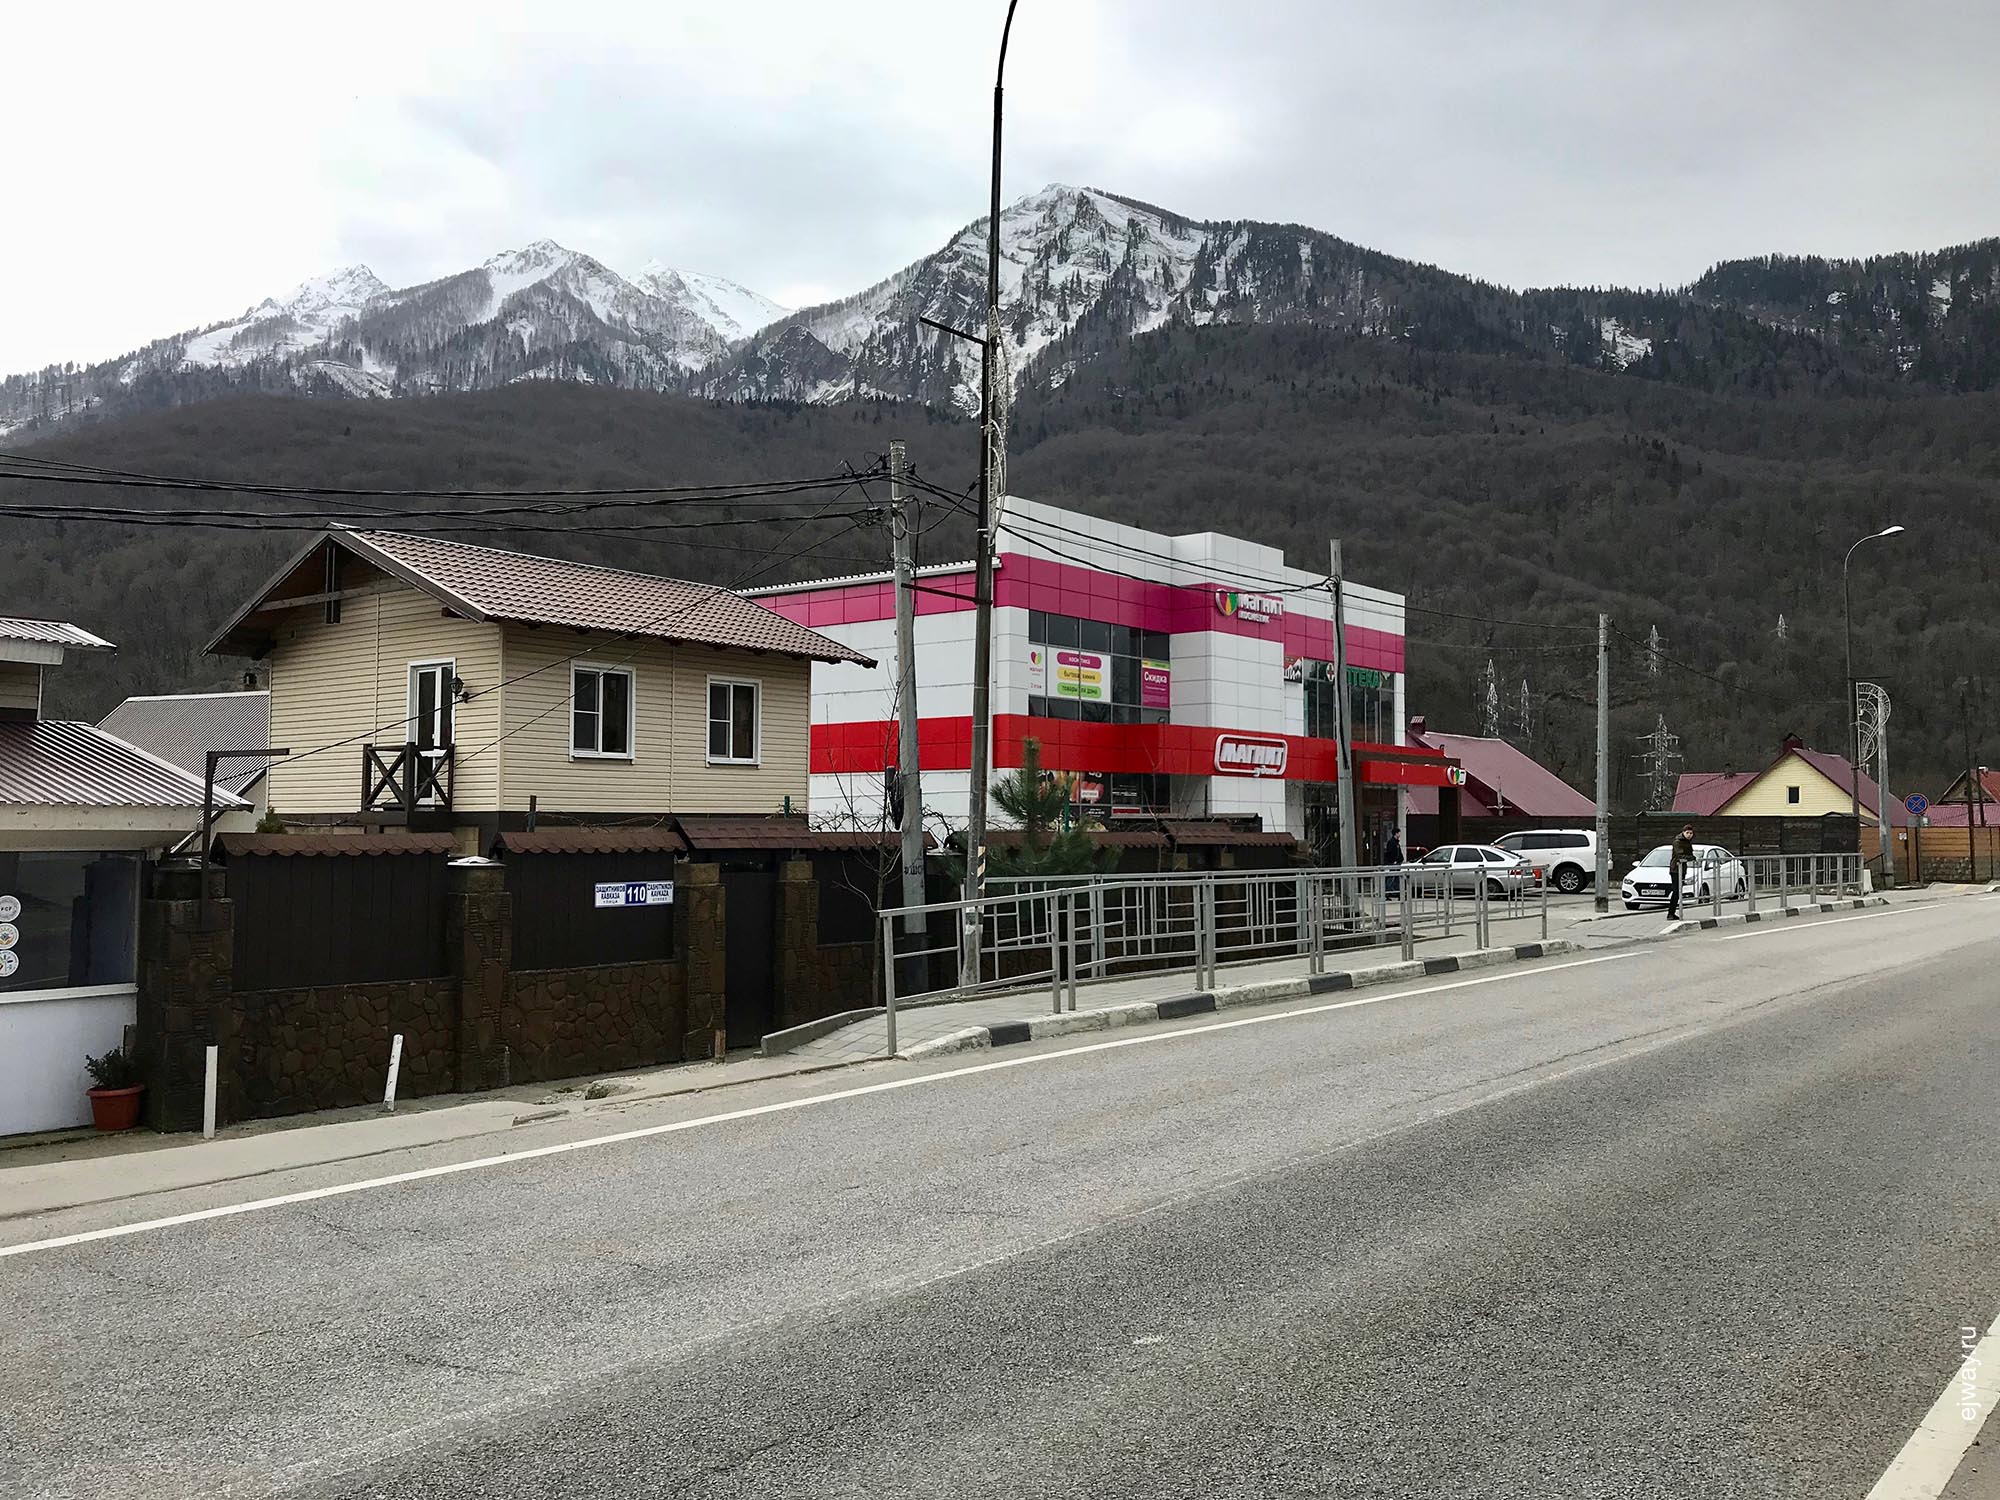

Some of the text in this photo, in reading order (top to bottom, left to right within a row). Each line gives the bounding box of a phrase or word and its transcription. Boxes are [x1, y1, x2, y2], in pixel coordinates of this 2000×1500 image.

[1144, 671, 1168, 684] Скидка
[1220, 742, 1284, 766] МАГНИТ
[595, 885, 626, 893] ЗАЩИТНИКОВ
[627, 886, 646, 902] 110
